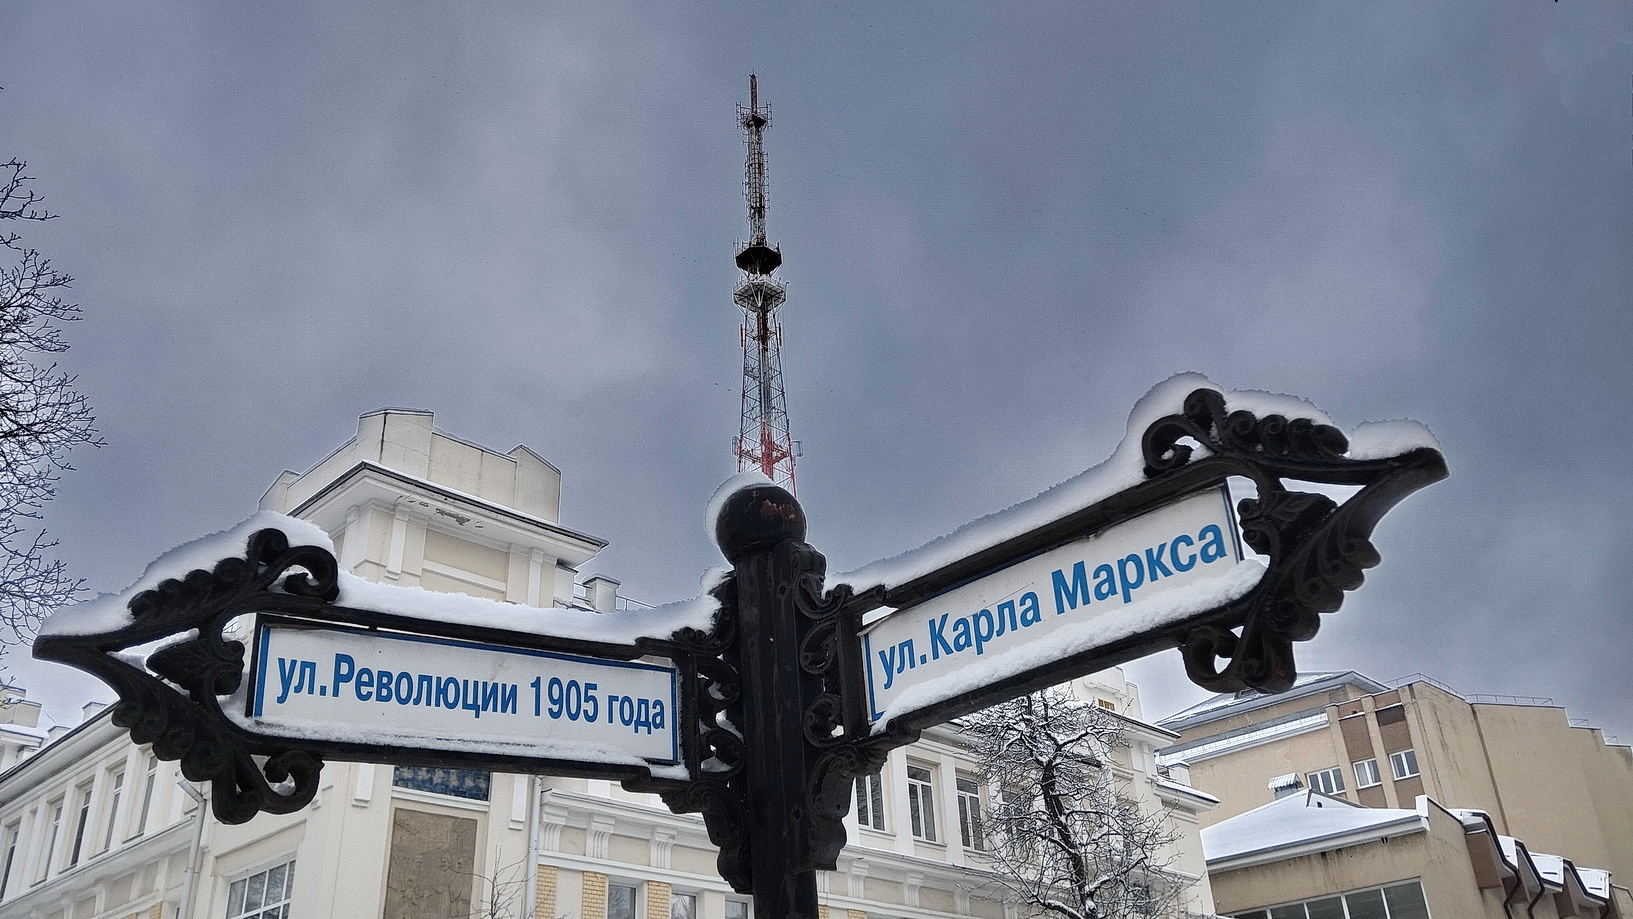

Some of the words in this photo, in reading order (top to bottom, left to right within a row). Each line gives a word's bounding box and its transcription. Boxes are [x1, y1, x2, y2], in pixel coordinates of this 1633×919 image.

[878, 591, 1042, 690] ул.Карла
[1051, 523, 1228, 615] Маркса
[276, 653, 518, 719] ул.Революции
[530, 676, 600, 723] 1905
[607, 694, 666, 735] года
